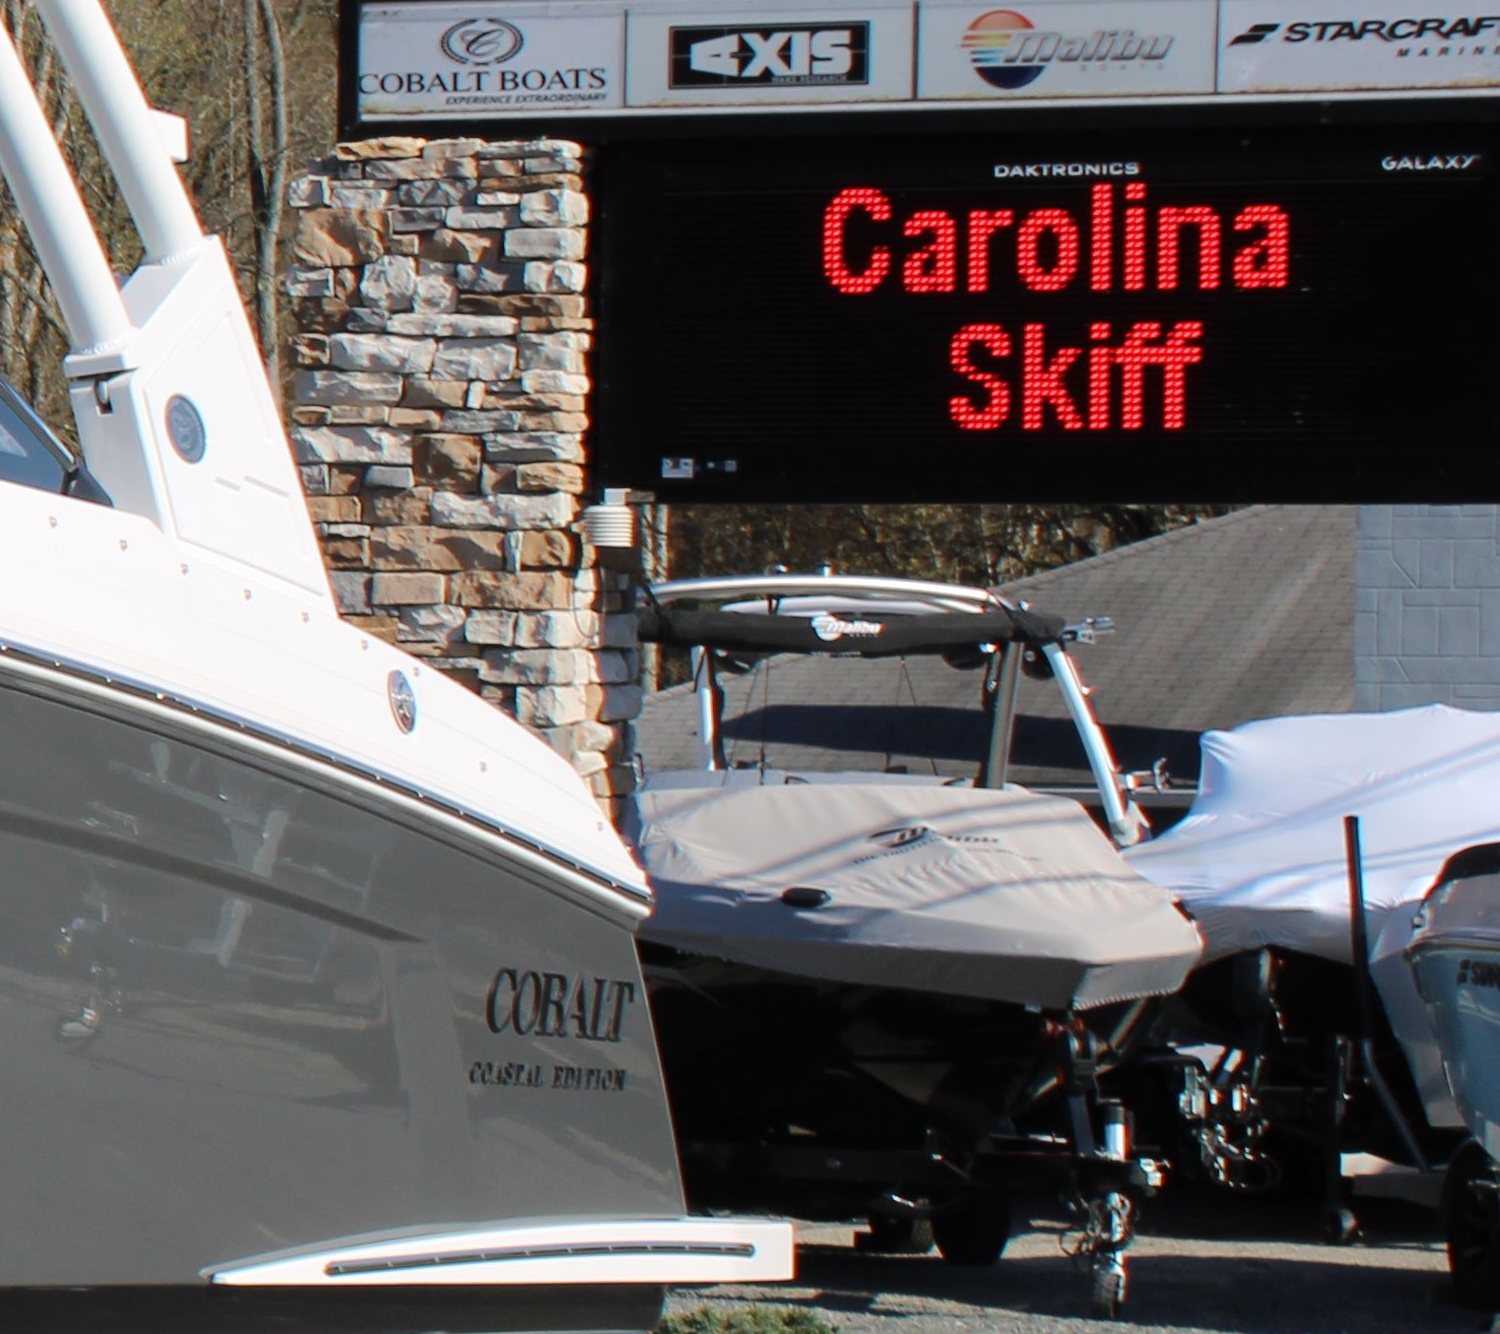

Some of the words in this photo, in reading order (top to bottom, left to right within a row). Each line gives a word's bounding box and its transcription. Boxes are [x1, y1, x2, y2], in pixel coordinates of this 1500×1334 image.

[690, 29, 853, 78] AXIS
[1003, 30, 1174, 64] Malibu
[359, 71, 490, 95] COBALT
[500, 67, 607, 92] BOATS
[445, 94, 512, 106] EXPERIENCE
[515, 92, 608, 104] EXTRAORDINARY
[994, 161, 1140, 178] DAKTRONICS
[823, 182, 1290, 295] Carolina
[949, 321, 1204, 431] Skiff
[486, 966, 635, 1042] COBALT
[468, 1062, 544, 1088] COASTAL
[551, 1065, 627, 1092] EDITION
